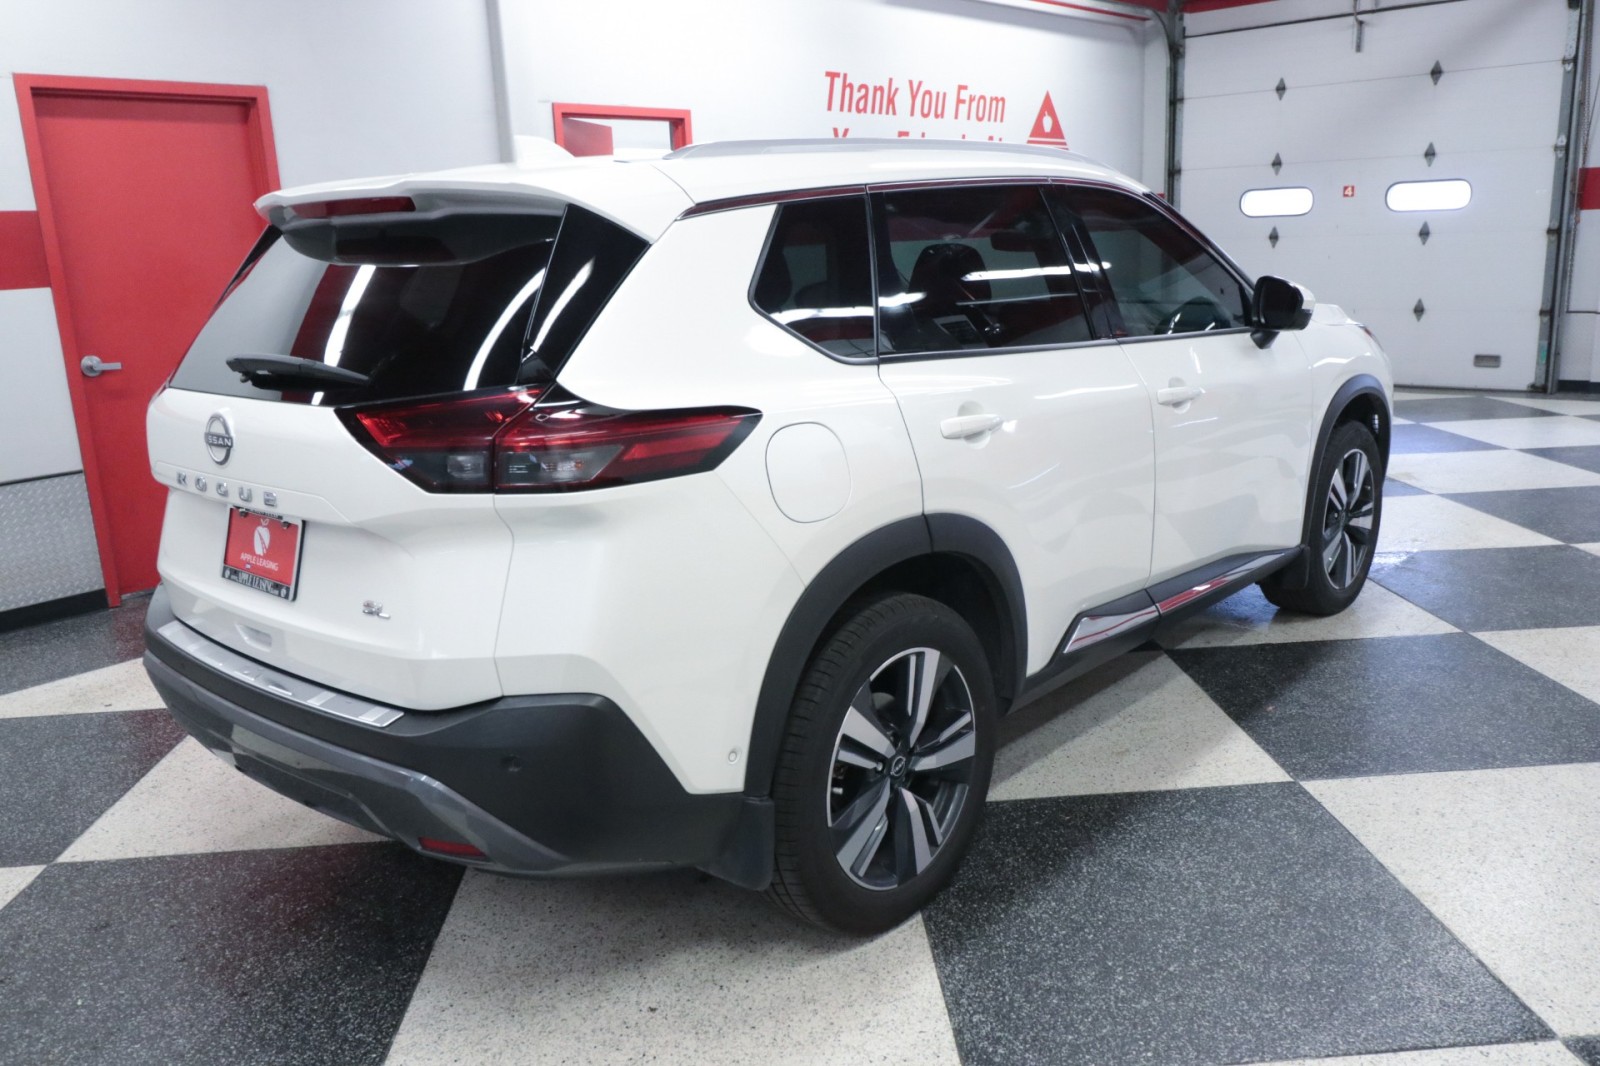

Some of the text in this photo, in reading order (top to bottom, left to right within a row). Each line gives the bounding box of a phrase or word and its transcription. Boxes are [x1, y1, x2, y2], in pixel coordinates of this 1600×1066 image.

[825, 71, 1006, 123] Thank You From
[1344, 186, 1353, 196] 4
[176, 472, 278, 508] ROGUE
[240, 552, 278, 571] APPLE LEASING
